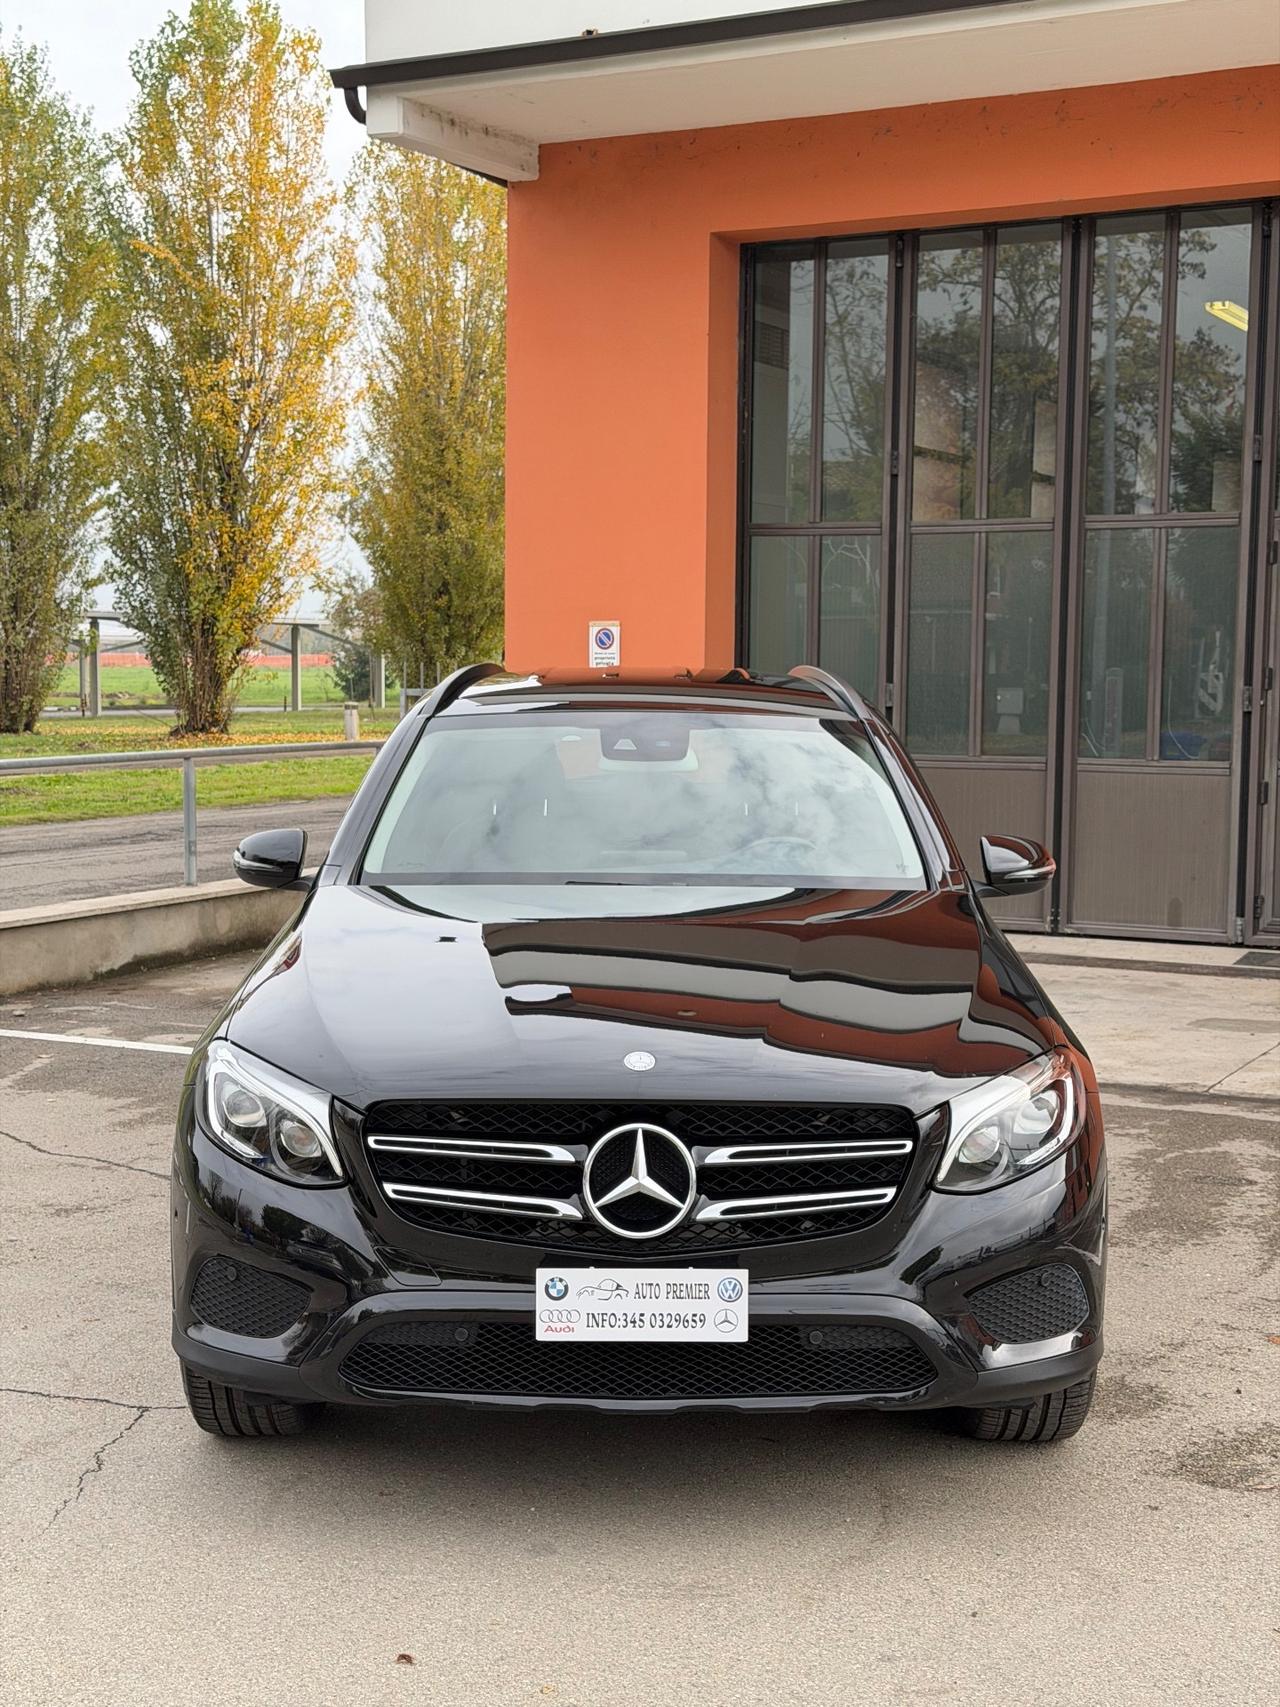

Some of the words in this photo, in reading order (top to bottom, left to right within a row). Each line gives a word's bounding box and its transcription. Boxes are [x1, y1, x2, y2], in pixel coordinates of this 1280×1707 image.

[634, 1282, 661, 1300] AUTO
[665, 1282, 711, 1300] PREMIER
[585, 1312, 646, 1329] INFO:345
[649, 1312, 707, 1329] 0329659
[544, 1325, 575, 1334] Audi
